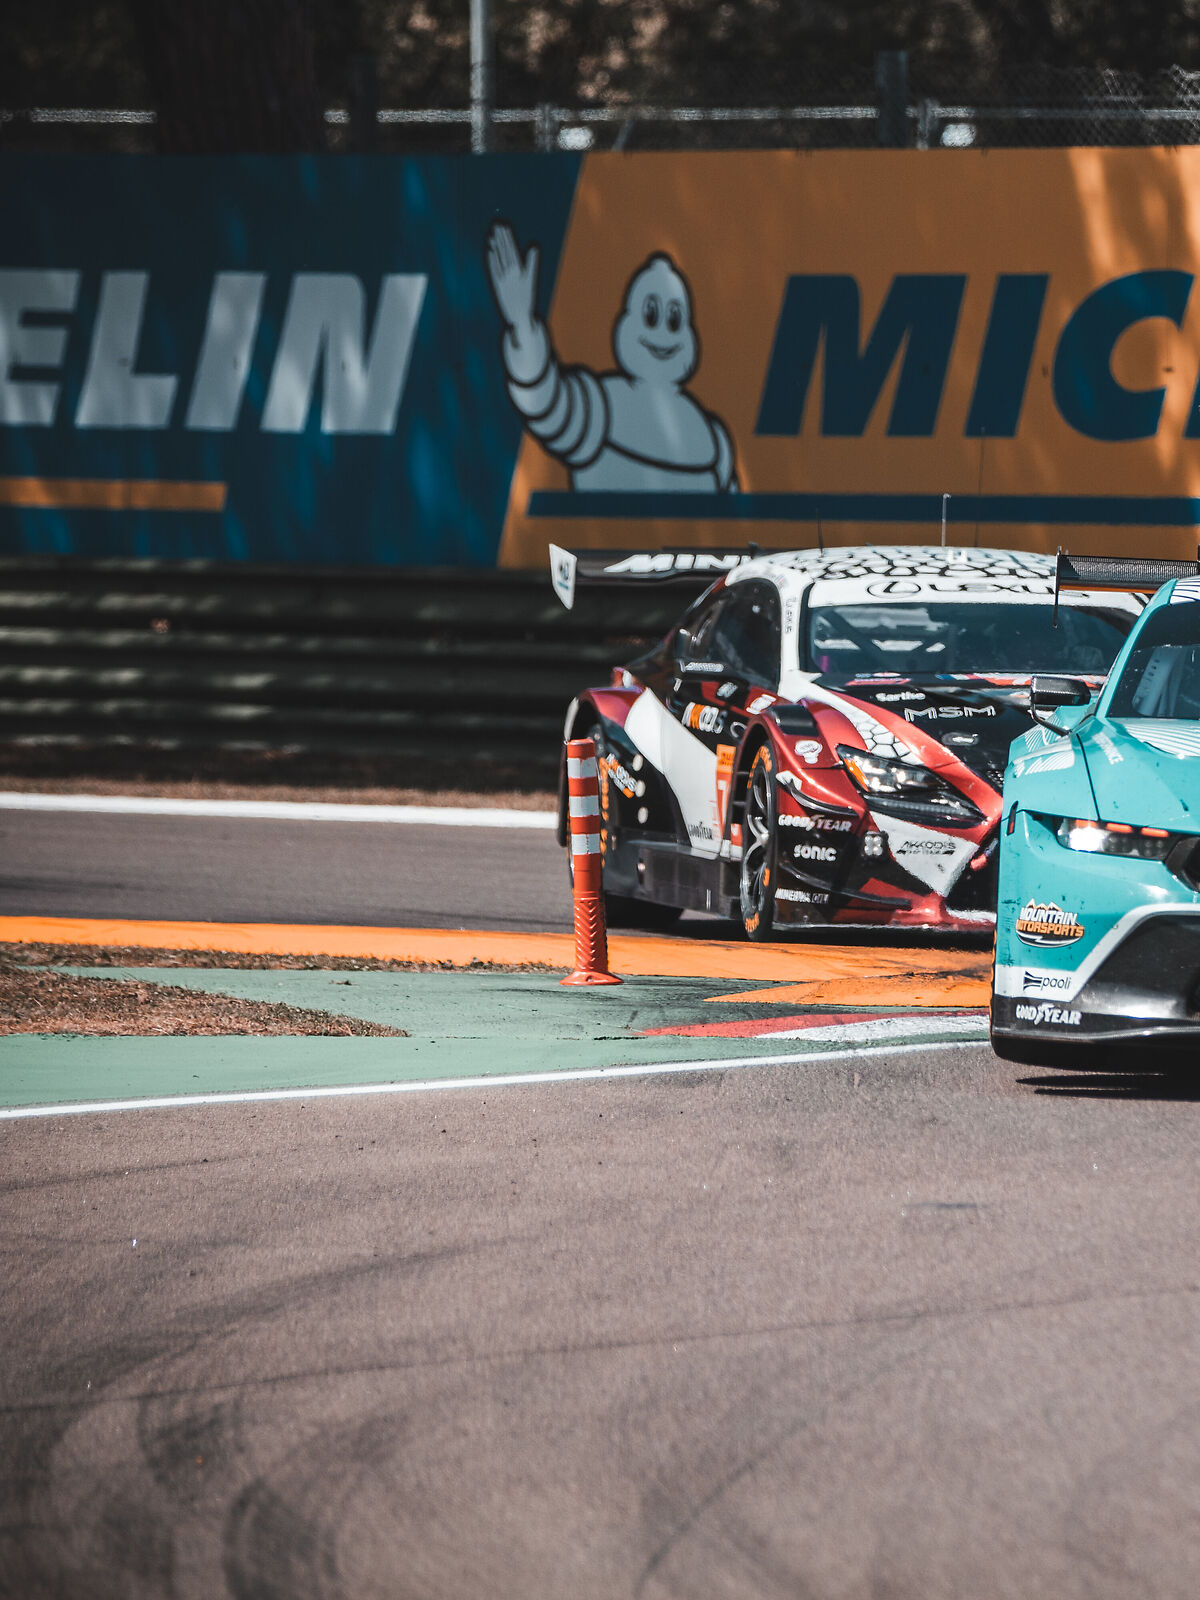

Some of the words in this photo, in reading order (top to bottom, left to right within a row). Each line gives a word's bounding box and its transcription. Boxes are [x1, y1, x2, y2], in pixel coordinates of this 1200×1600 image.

[904, 704, 996, 722] MSM
[778, 814, 852, 832] GOODYEAR
[1019, 907, 1078, 926] MOUNTAIN
[1041, 976, 1072, 991] paoli
